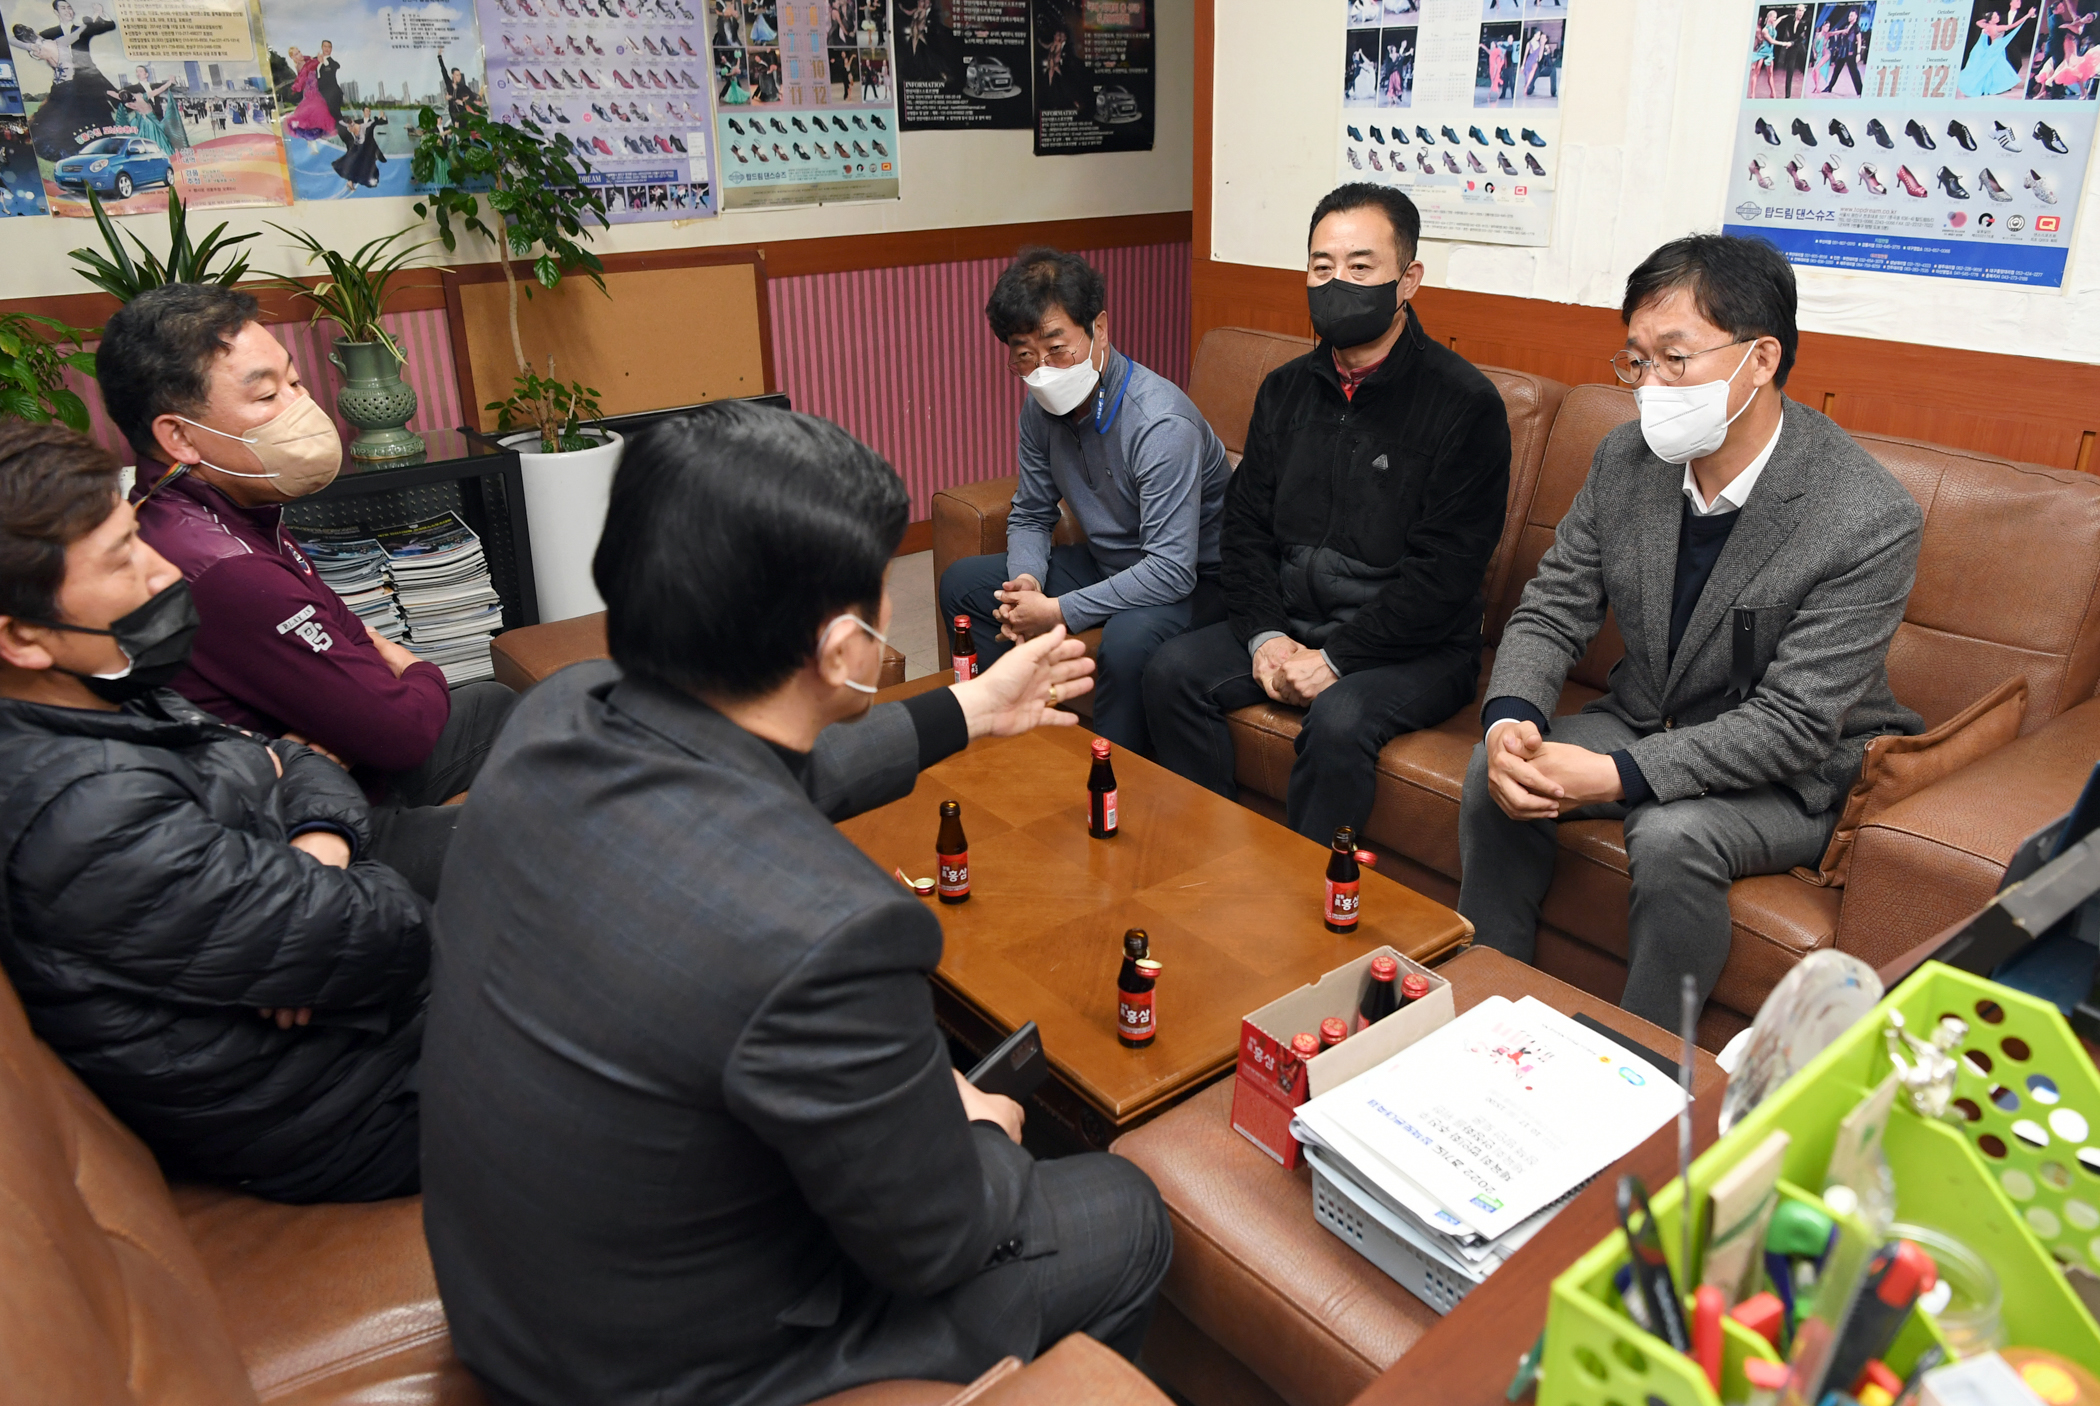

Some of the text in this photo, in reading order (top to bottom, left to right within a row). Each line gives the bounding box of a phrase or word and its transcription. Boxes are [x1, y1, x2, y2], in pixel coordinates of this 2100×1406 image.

[785, 6, 794, 26] 5
[787, 33, 794, 52] 7
[1886, 19, 1904, 53] 9
[1930, 17, 1958, 51] 10
[812, 60, 825, 79] 10
[1876, 66, 1901, 97] 11
[1922, 65, 1949, 98] 12
[789, 87, 827, 105] 11 12
[1041, 109, 1078, 117] INFORMATION
[763, 171, 787, 180] 댄스슈즈
[1764, 206, 1836, 222] 탑드림 댄스슈즈
[1840, 207, 1897, 215] www.topdream.co.kr
[282, 608, 312, 630] PLAY IN
[947, 867, 968, 882] 홍삼
[1125, 1008, 1151, 1024] 홍삼
[1253, 1046, 1276, 1072] 홍삼
[1428, 1119, 1451, 1133] 추진
[1433, 1106, 1524, 1174] 체육회 안정화를 위한
[1449, 1133, 1483, 1157] 법인화
[1472, 1116, 1538, 1165] 정책 방안 토론
[1432, 1145, 1464, 1169] 경기도
[1479, 1155, 1512, 1182] 체육회
[1463, 1169, 1496, 1193] 2022
